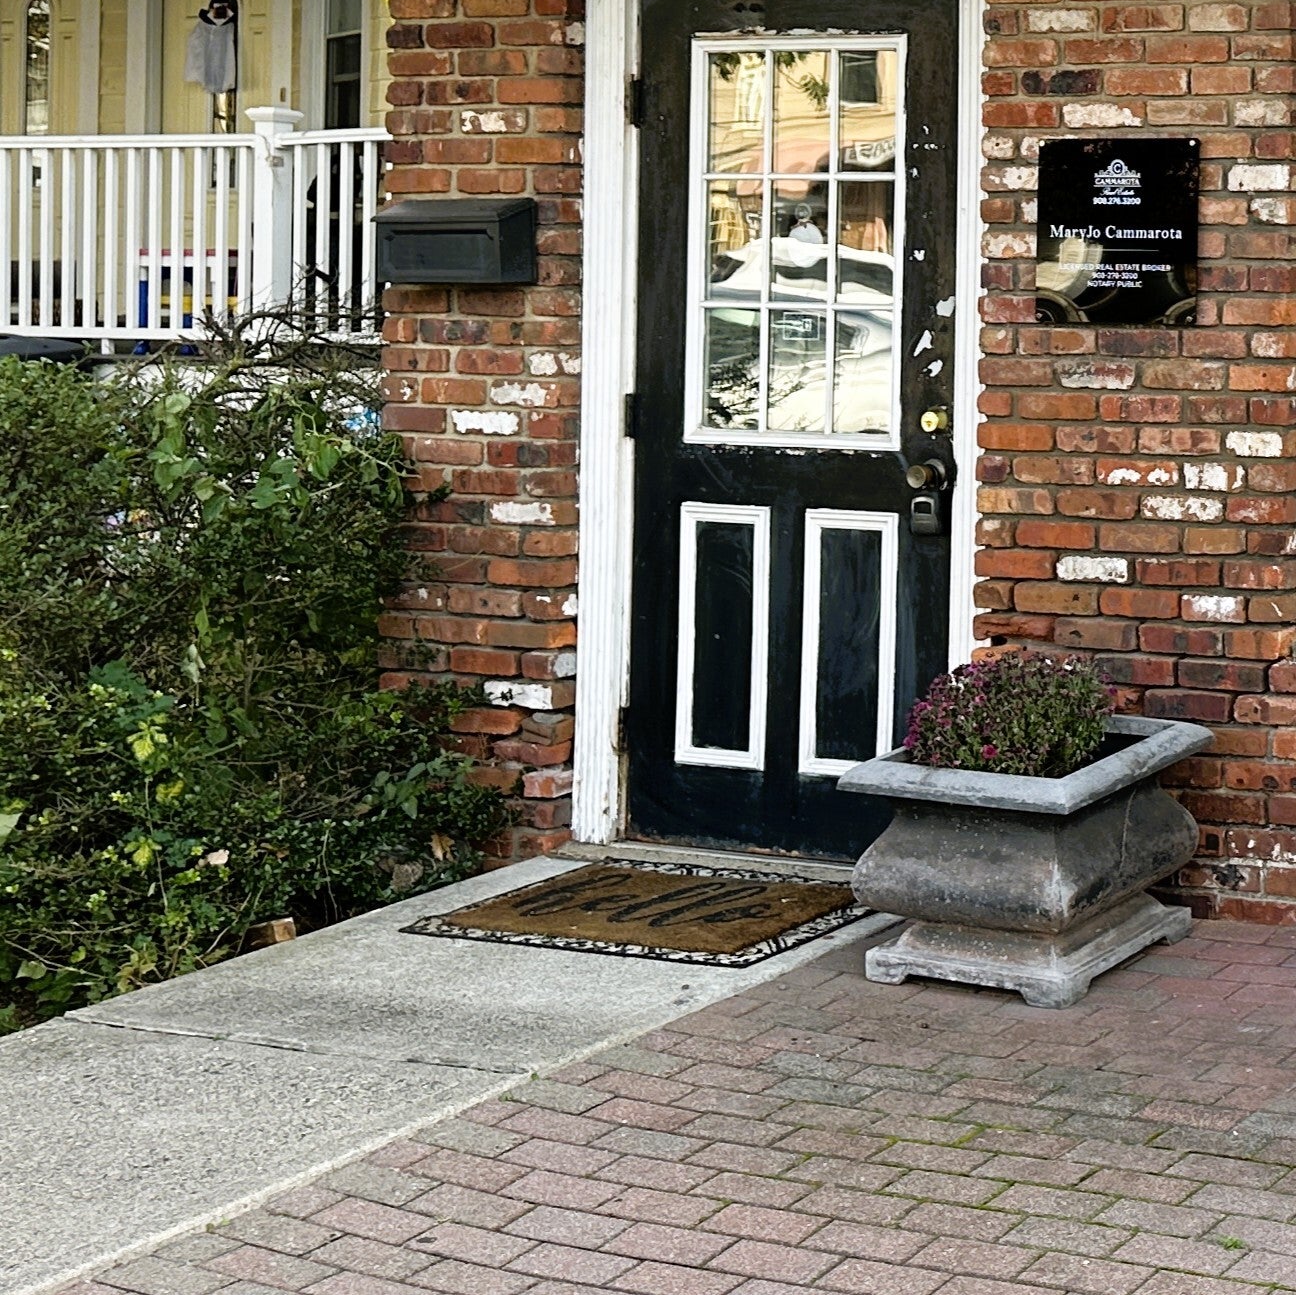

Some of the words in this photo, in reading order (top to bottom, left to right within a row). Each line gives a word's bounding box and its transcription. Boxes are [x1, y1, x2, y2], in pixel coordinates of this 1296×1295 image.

[1050, 225, 1102, 242] MaryJo
[1105, 226, 1183, 240] Cammarota
[511, 873, 783, 927] hello
